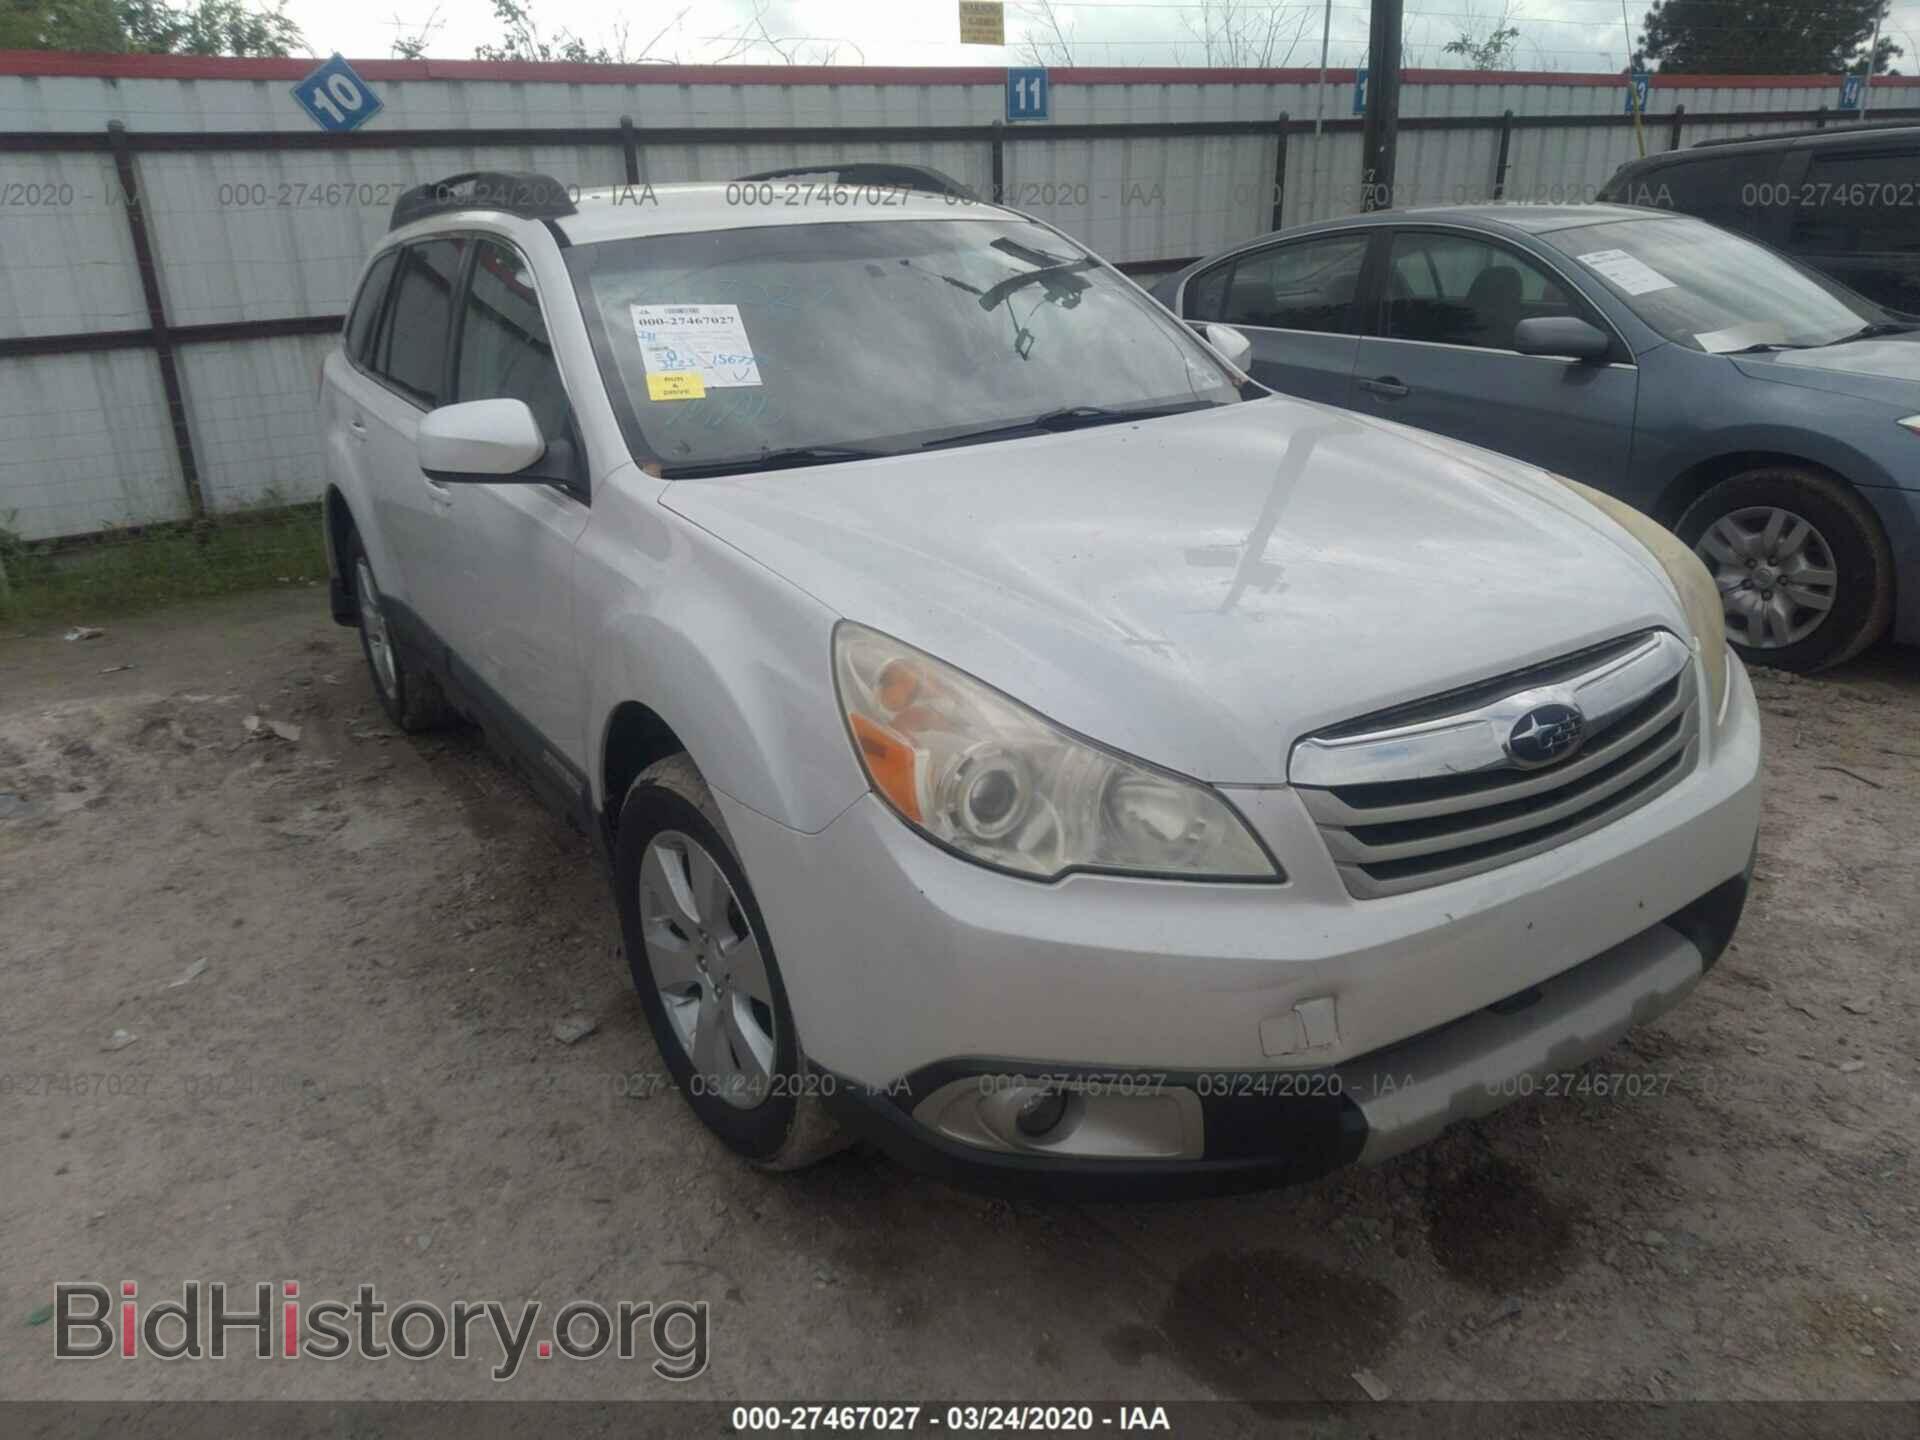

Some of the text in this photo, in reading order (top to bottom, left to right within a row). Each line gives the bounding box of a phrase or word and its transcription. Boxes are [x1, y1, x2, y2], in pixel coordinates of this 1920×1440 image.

[313, 73, 362, 123] 10
[1015, 77, 1041, 111] 11
[639, 315, 734, 327] 000-27467027
